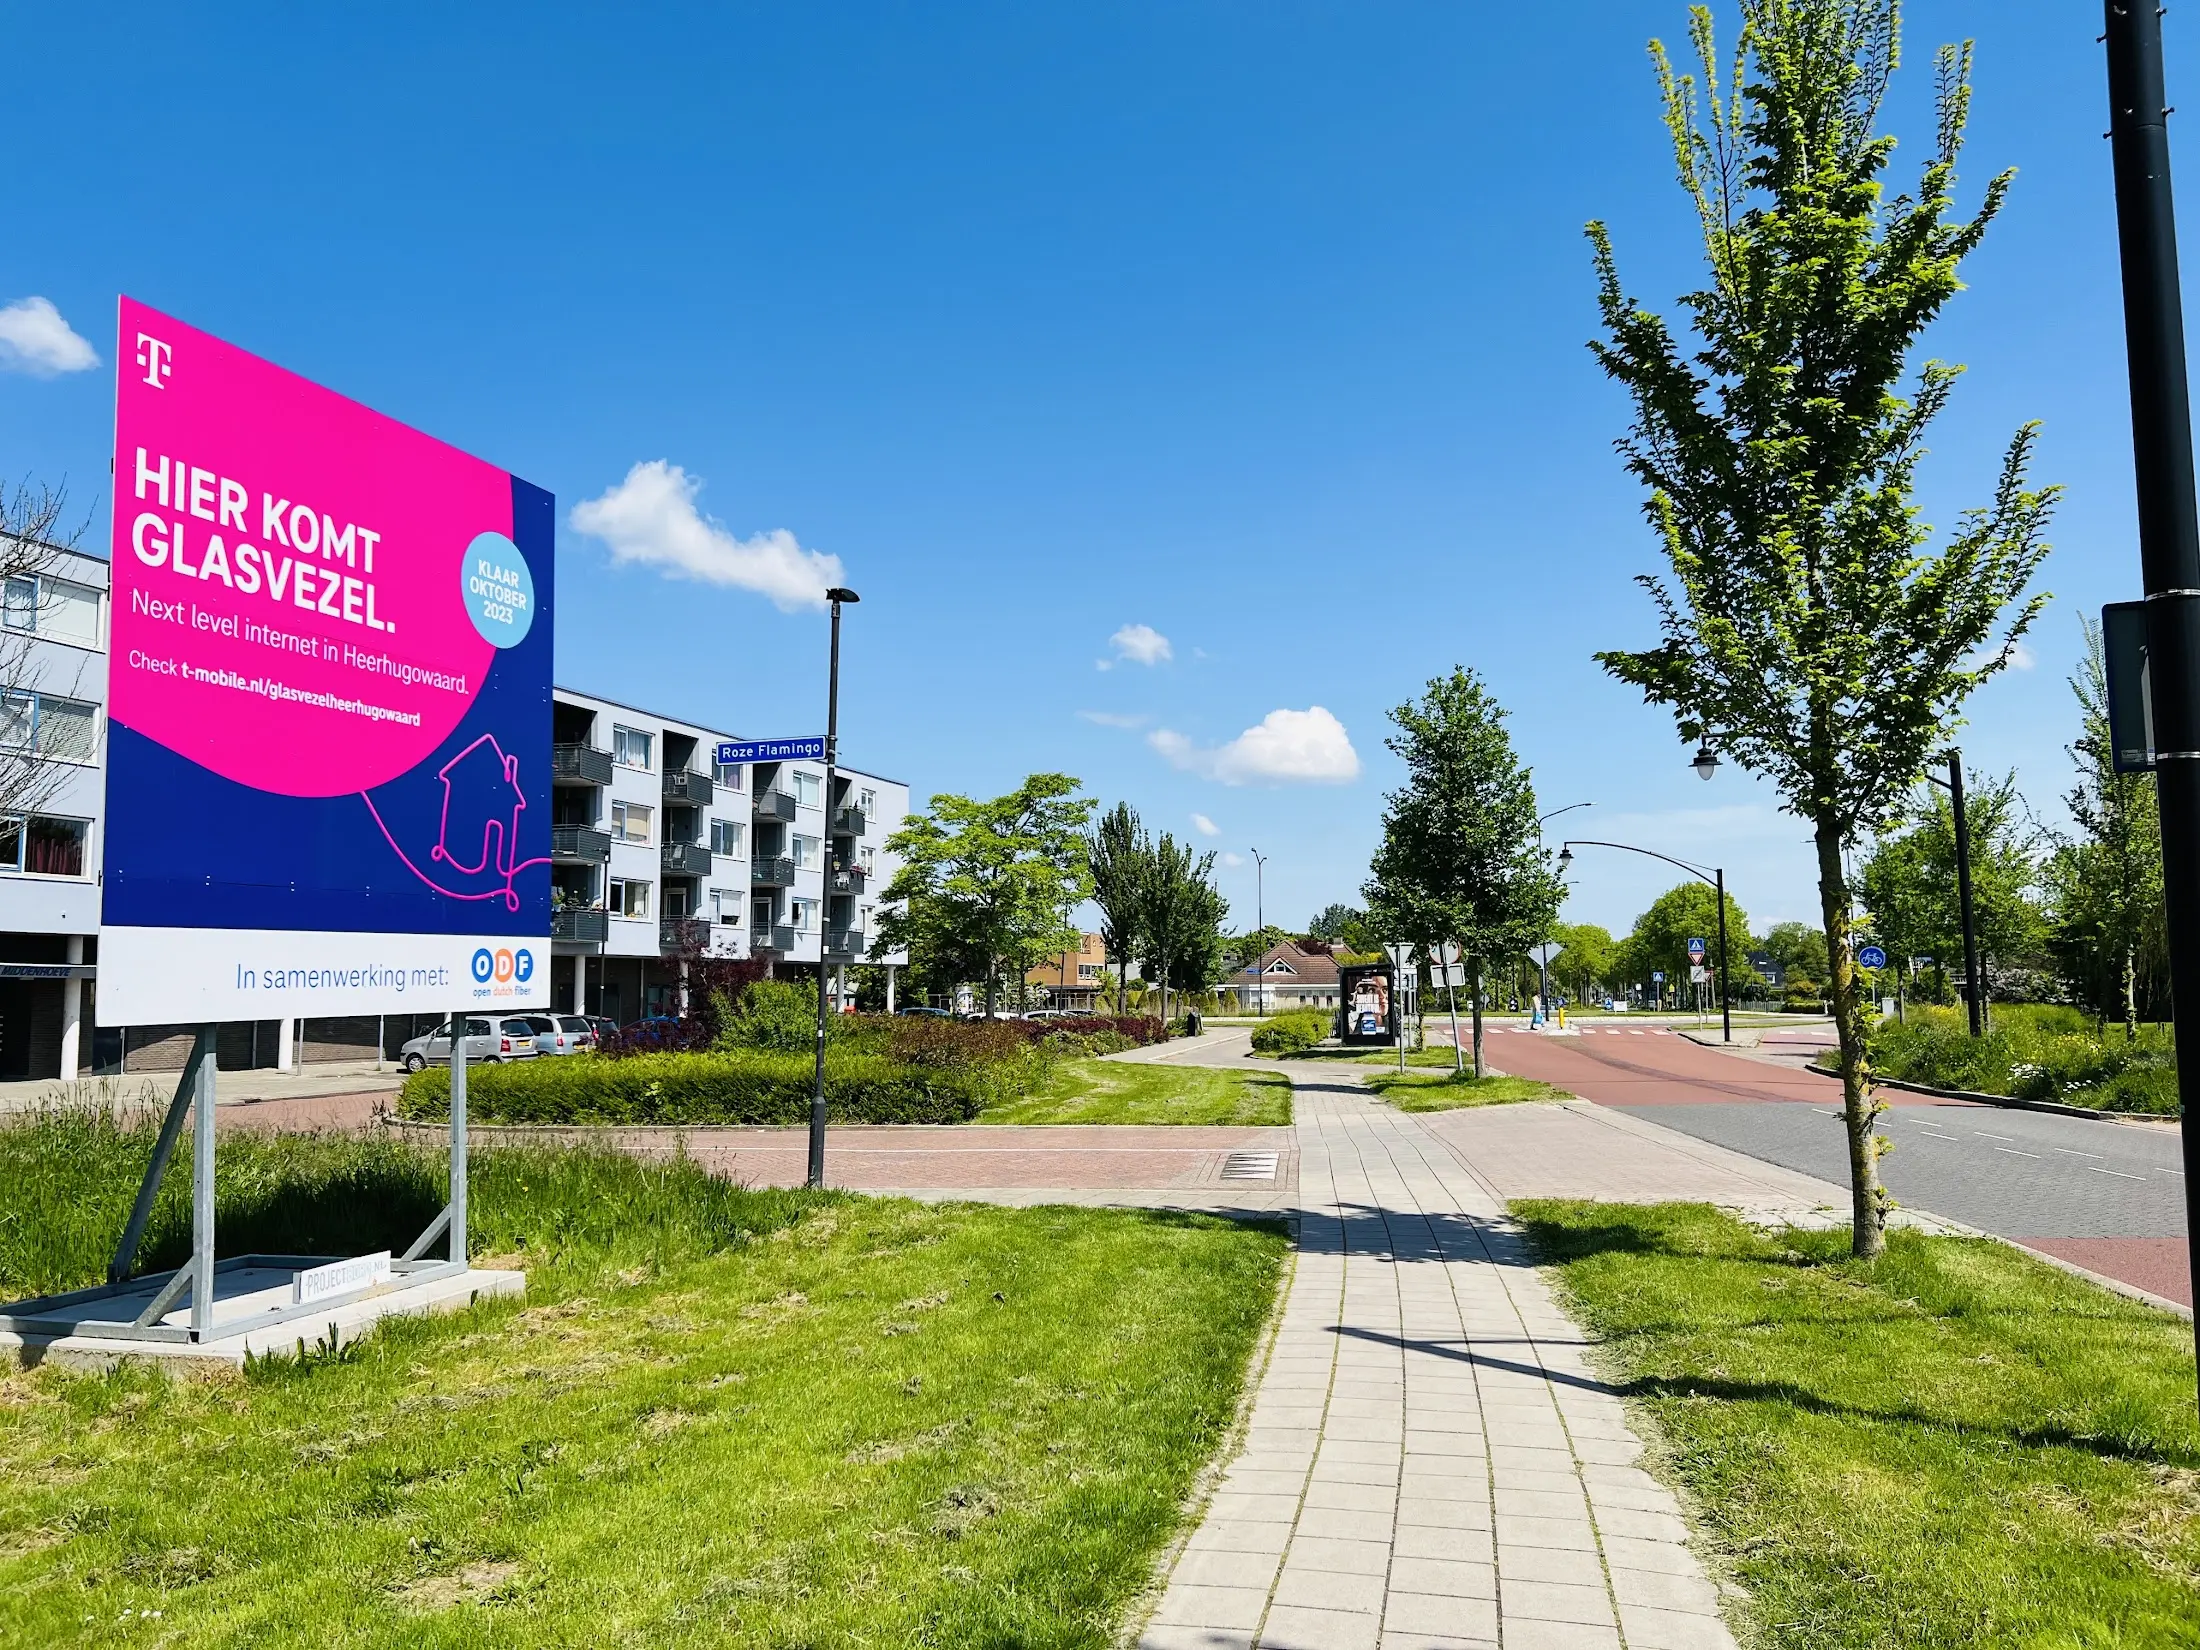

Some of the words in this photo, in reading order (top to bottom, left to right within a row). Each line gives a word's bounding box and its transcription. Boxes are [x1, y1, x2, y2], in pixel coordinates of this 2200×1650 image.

[135, 446, 249, 533] HIER
[262, 492, 381, 574] KOMT
[132, 512, 396, 634] GLASVEZEL.
[478, 559, 519, 588] KLAAR
[470, 576, 527, 611] OKTOBER
[483, 600, 513, 624] 2023
[132, 588, 185, 625] Next
[191, 603, 239, 639] level
[245, 621, 318, 658] internet
[323, 638, 338, 662] in
[344, 644, 469, 695] Heerhugowaard.
[128, 650, 178, 676] Check
[181, 661, 420, 727] t-mobile.nl/glasvezelheerhugowaard
[722, 747, 753, 758] Roze
[758, 743, 820, 756] Flamingo
[237, 963, 256, 989] In
[263, 963, 406, 992] samenwerking
[411, 965, 449, 987] met:
[474, 952, 530, 979] ODF
[473, 989, 491, 1000] open
[493, 986, 513, 996] dutch
[515, 985, 531, 996] fiber
